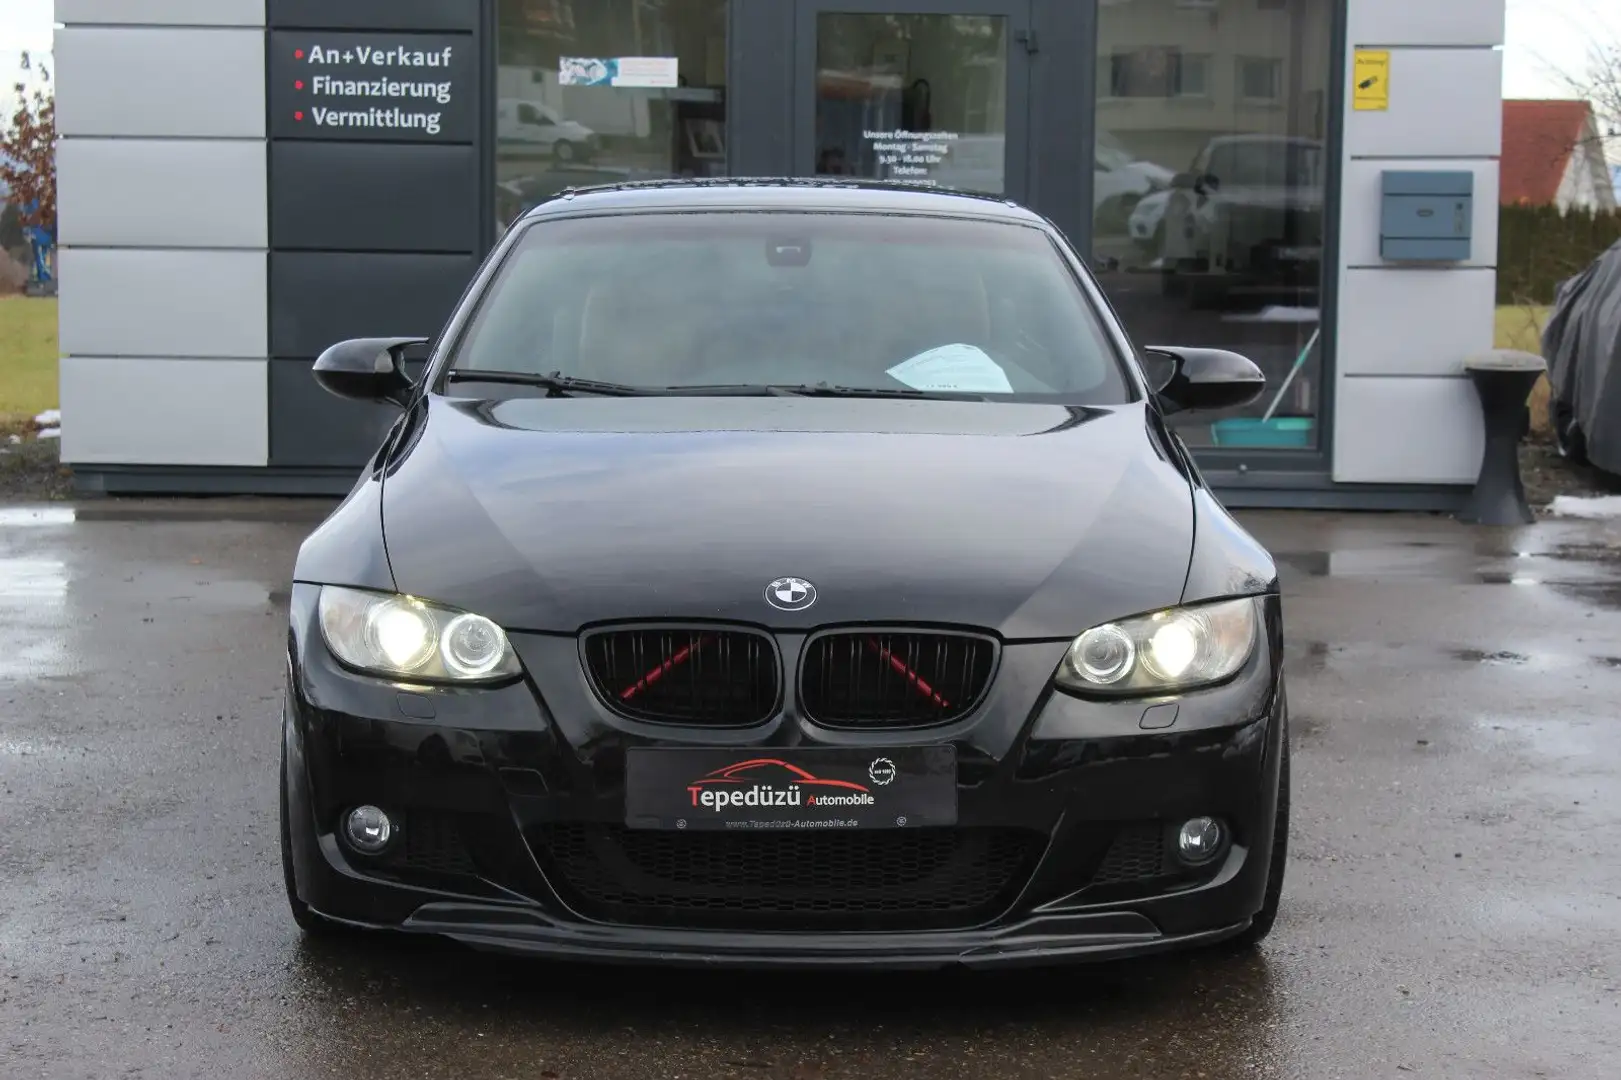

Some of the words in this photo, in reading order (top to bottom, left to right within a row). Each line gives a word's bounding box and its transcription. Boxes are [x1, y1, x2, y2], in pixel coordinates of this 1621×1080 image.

[308, 45, 452, 67] An+Verkauf
[312, 75, 452, 103] Finanzierung
[311, 106, 441, 134] Vermittlung
[873, 142, 907, 153] Montag
[687, 785, 801, 812] Tepedüzü
[807, 793, 874, 807] Automobile
